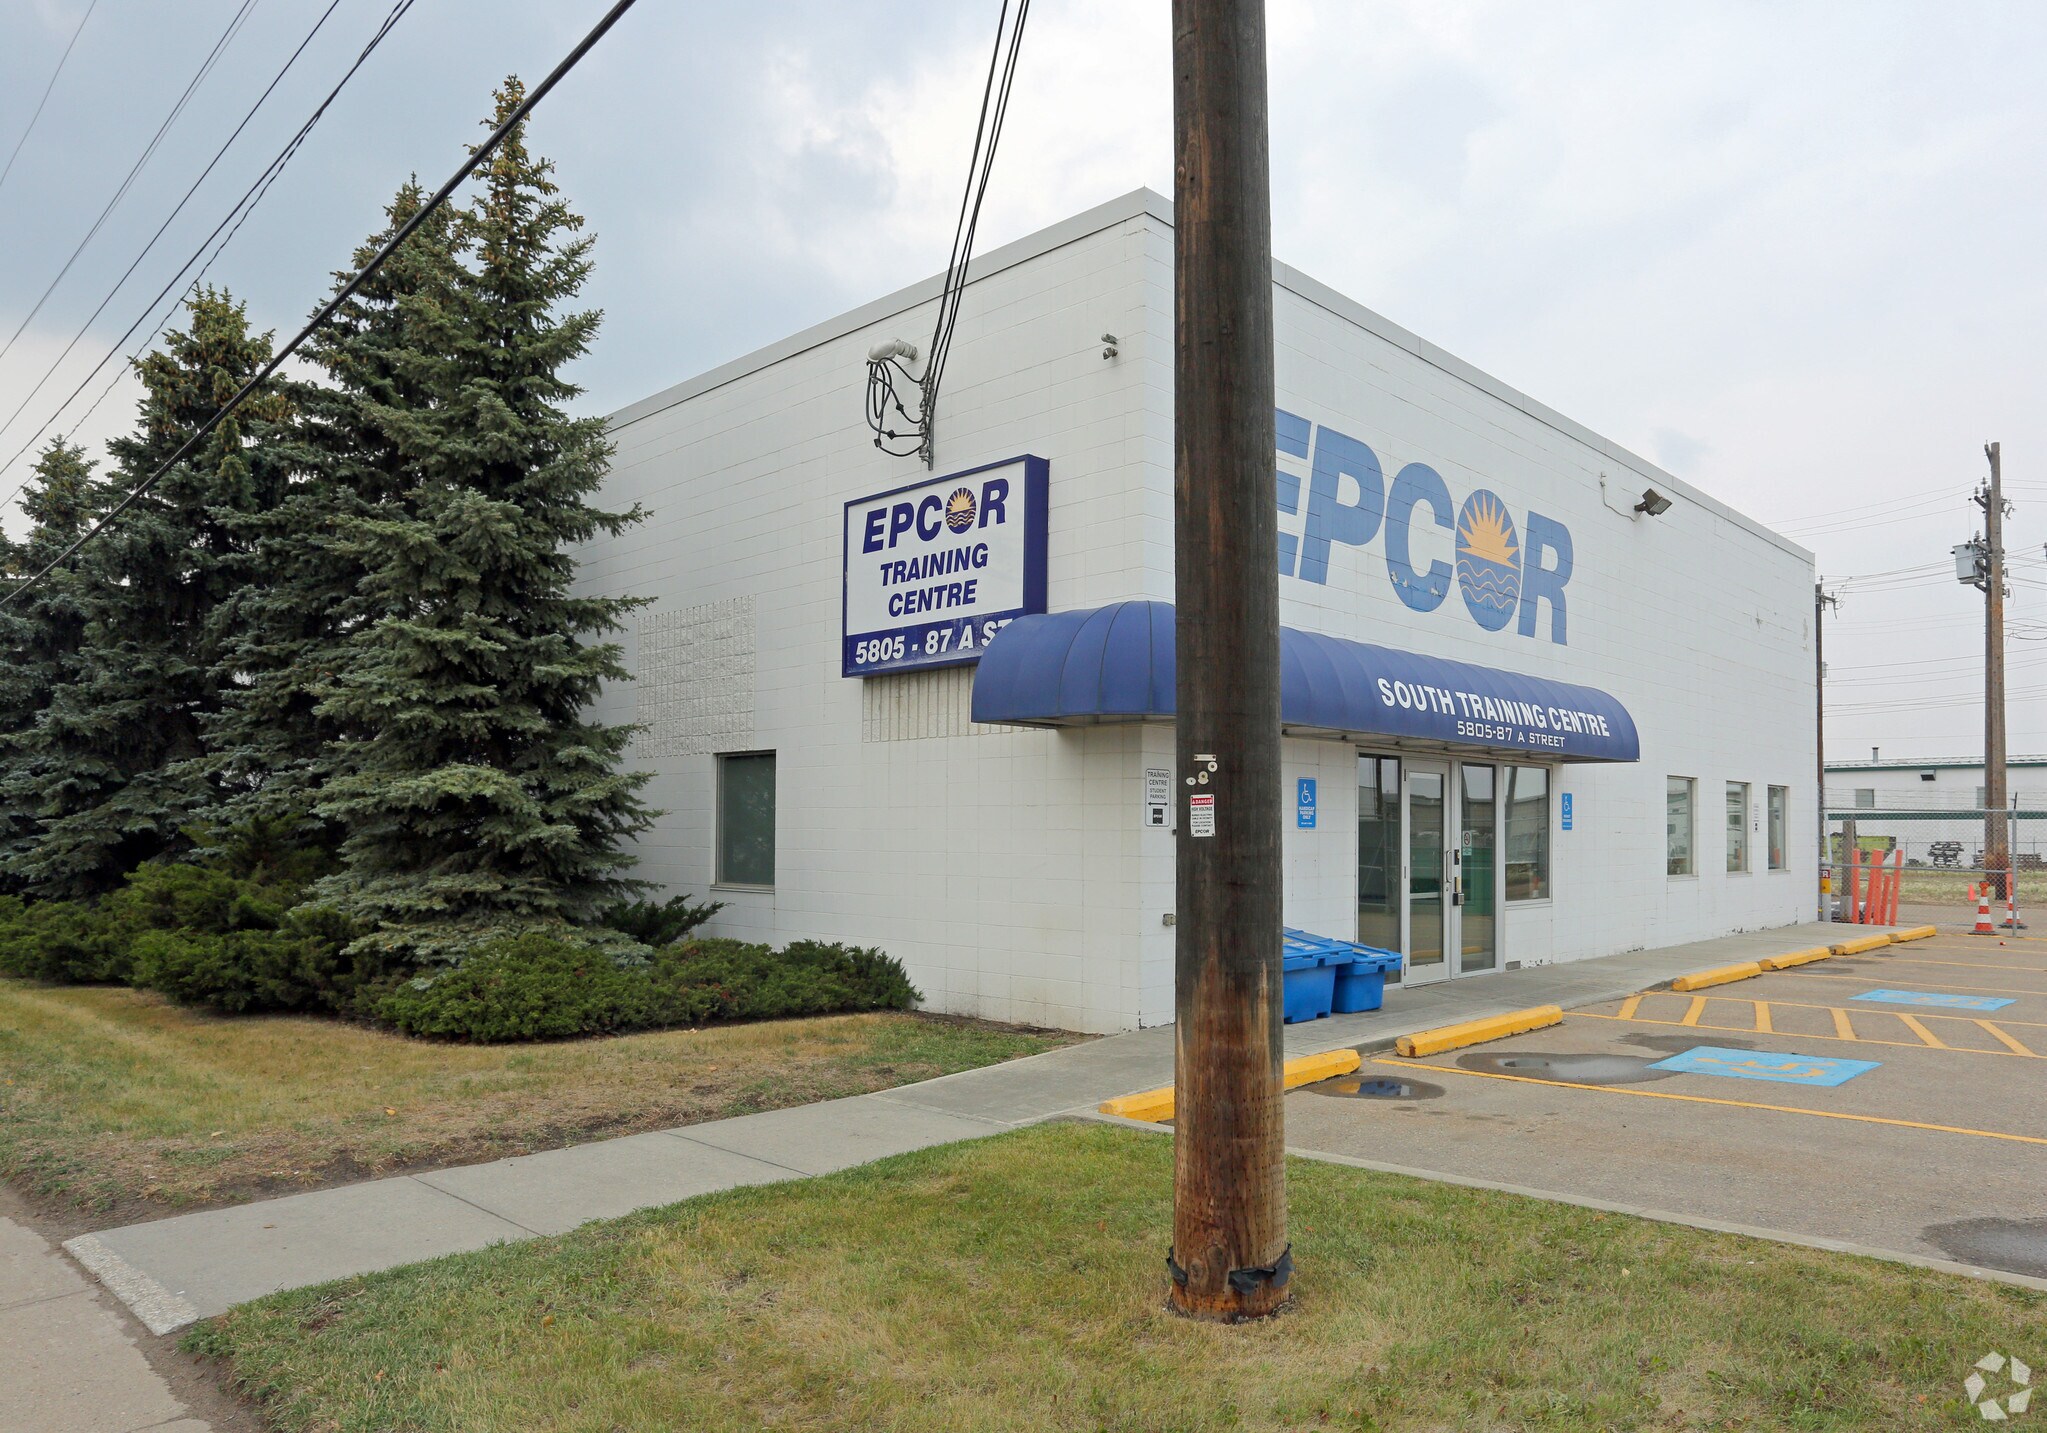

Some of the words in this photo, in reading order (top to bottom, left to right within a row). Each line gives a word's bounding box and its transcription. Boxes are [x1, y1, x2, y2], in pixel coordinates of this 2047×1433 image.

[862, 478, 1009, 554] EPCOR
[880, 542, 989, 586] TRAINING
[888, 579, 978, 617] CENTRE
[855, 636, 905, 664] 5805
[925, 629, 953, 655] 87
[958, 624, 975, 650] A
[1377, 678, 1456, 715] SOUTH
[1455, 691, 1547, 729] TRAINING
[1548, 707, 1610, 737] CENTRE
[1457, 720, 1512, 741] 5805-87
[1517, 731, 1525, 743] A
[1529, 732, 1565, 748] STREET
